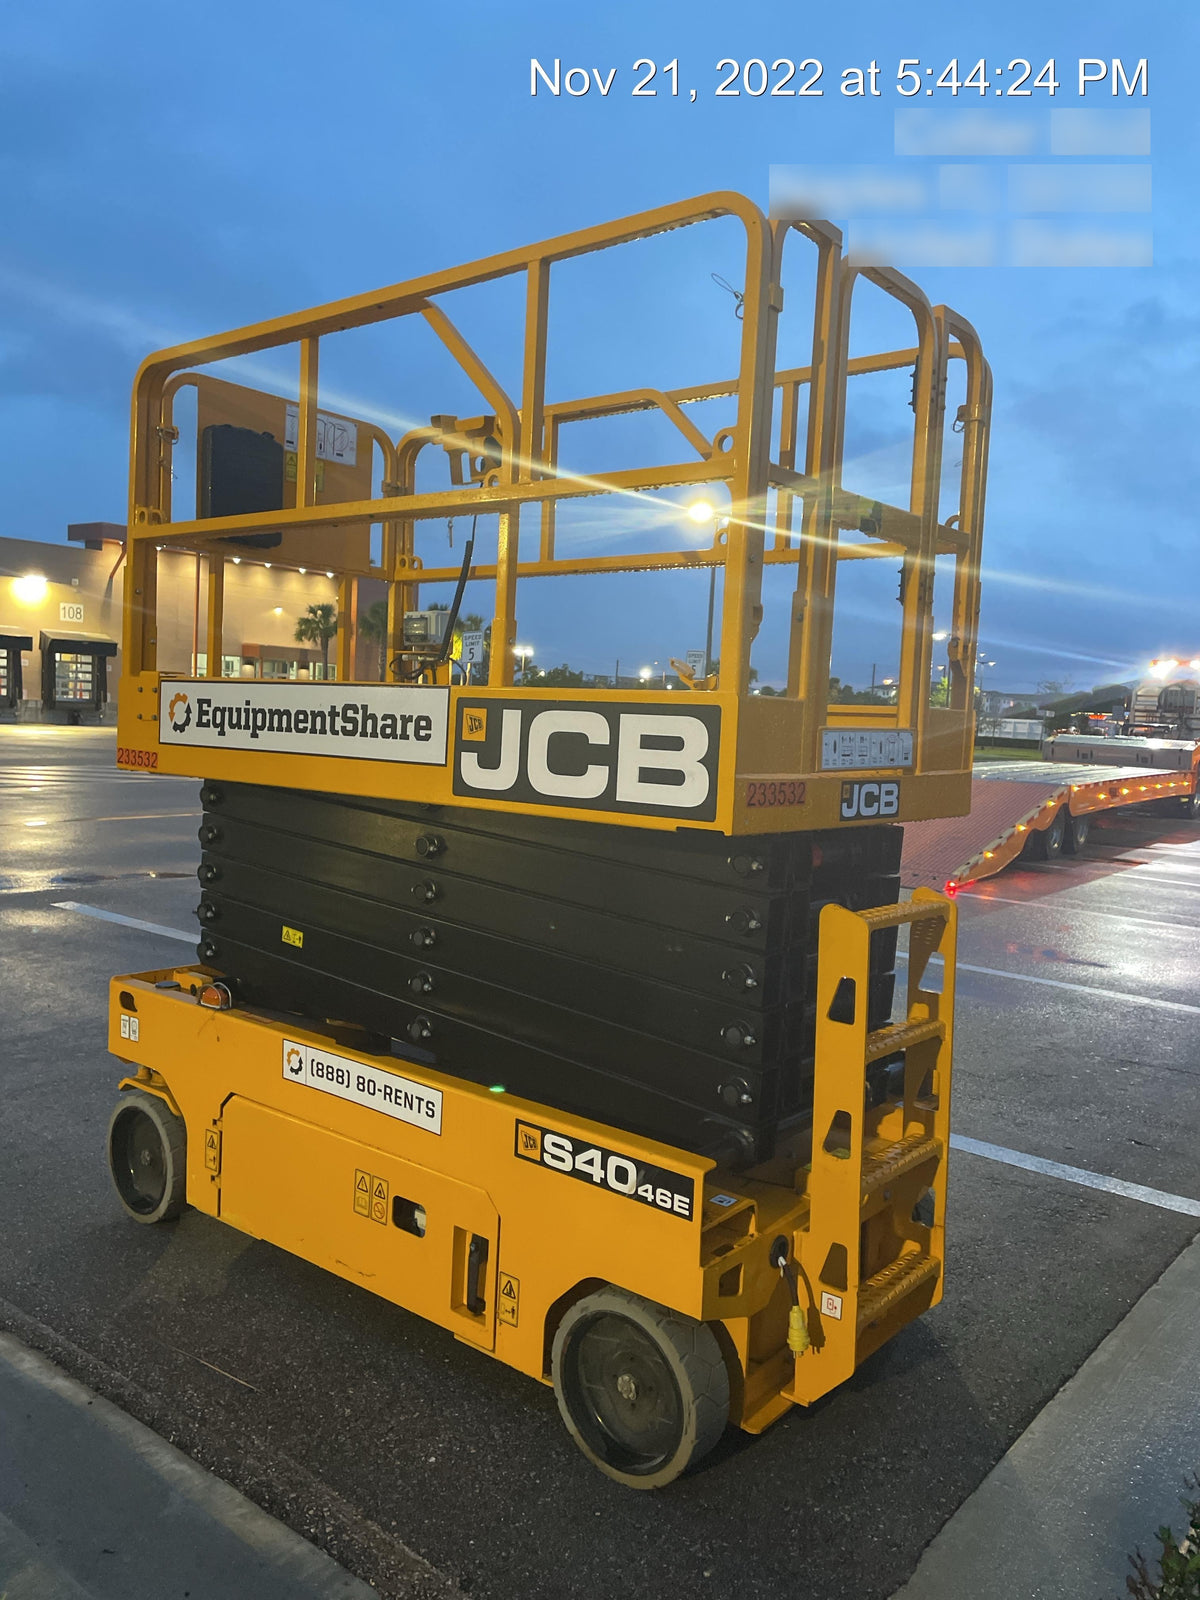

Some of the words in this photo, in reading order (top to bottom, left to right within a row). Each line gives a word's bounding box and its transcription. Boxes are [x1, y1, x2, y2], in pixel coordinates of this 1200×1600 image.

[61, 606, 82, 620] 108
[468, 648, 475, 661] 5
[196, 697, 432, 742] EquipmentShare
[117, 747, 158, 769] 233532
[460, 708, 710, 808] JCB
[747, 782, 806, 807] 233532
[841, 783, 899, 818] JCB
[310, 1058, 351, 1089] (888)
[356, 1076, 436, 1119] 80-RENTS
